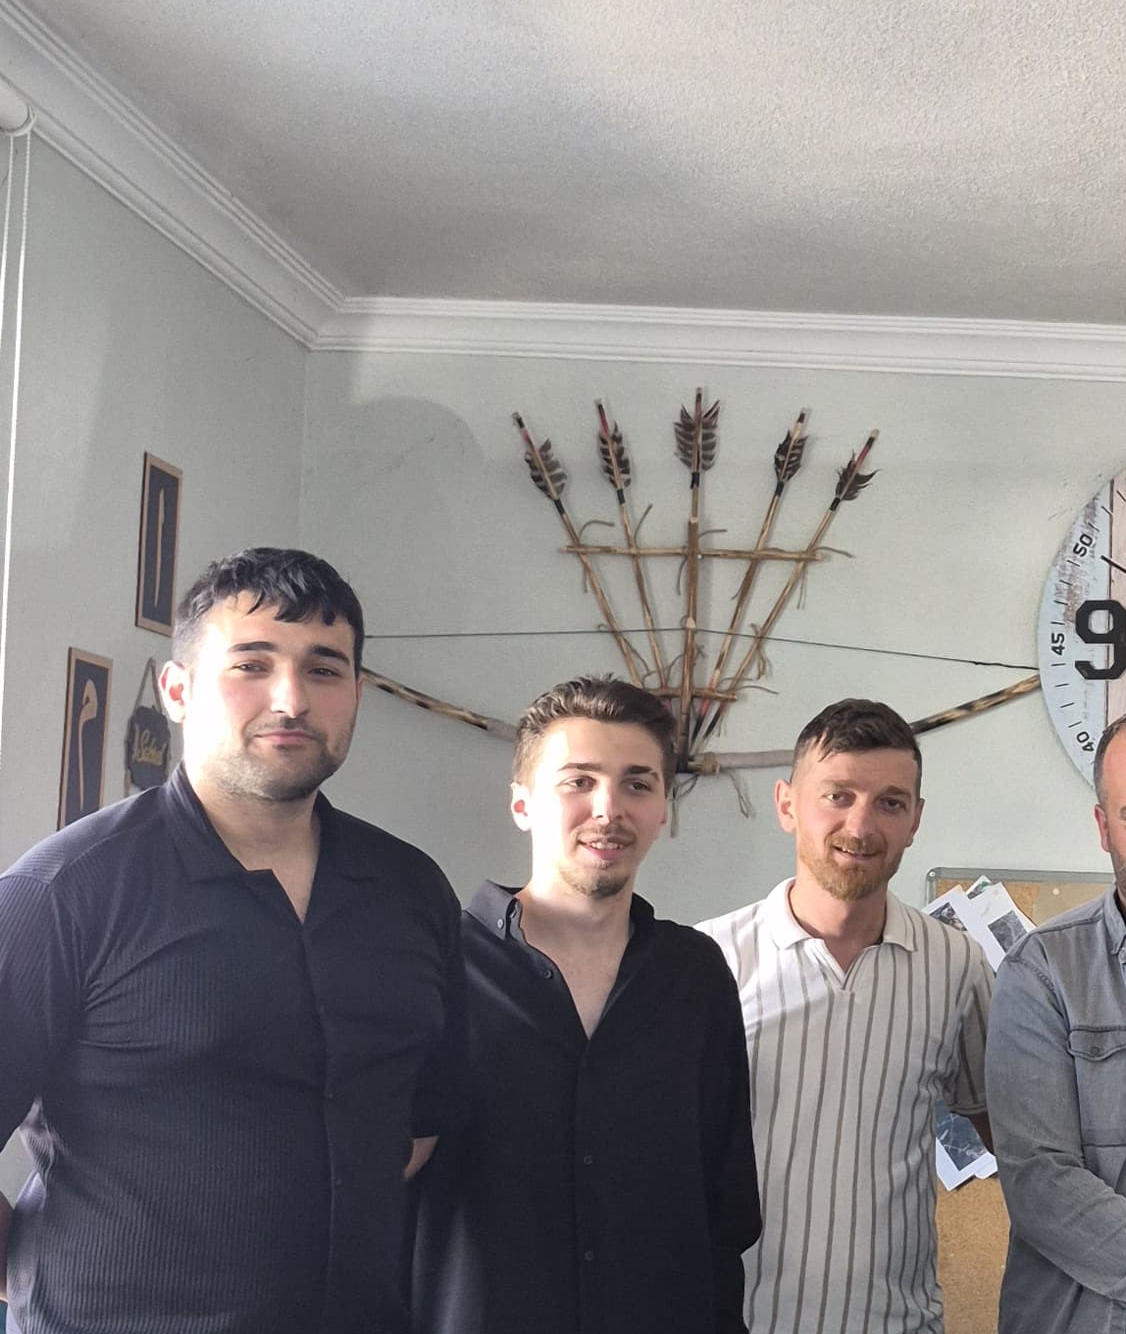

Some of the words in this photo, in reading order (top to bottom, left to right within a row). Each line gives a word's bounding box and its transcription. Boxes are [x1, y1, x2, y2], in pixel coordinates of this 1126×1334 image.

[1073, 533, 1093, 557] 50
[1051, 632, 1066, 656] 45
[1076, 731, 1095, 752] 40
